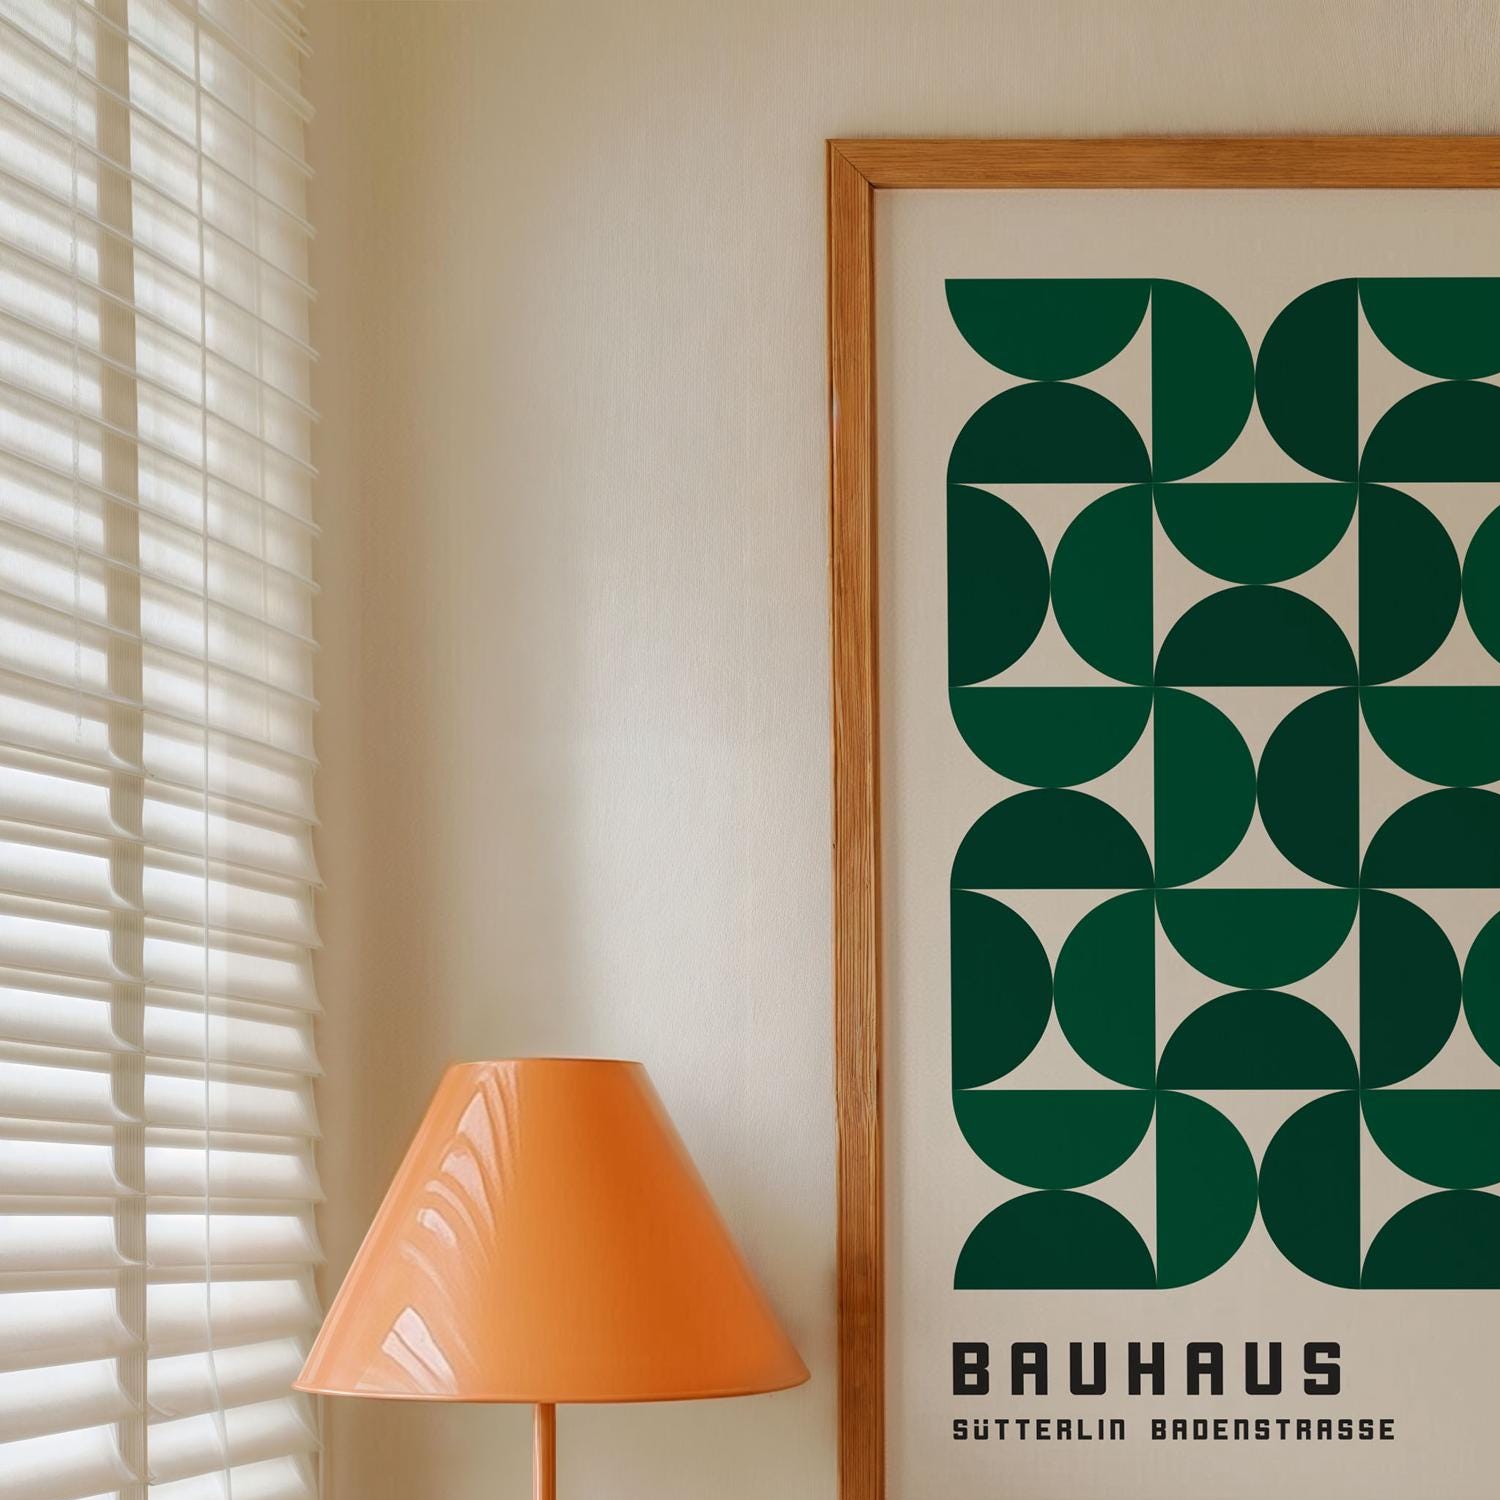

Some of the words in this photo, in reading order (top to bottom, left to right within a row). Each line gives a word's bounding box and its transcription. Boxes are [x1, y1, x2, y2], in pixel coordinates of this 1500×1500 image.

[952, 1341, 1342, 1396] BAUHAUS
[952, 1418, 1126, 1441] SÜTTERLIN
[1151, 1418, 1395, 1441] BADENSTRASSE
